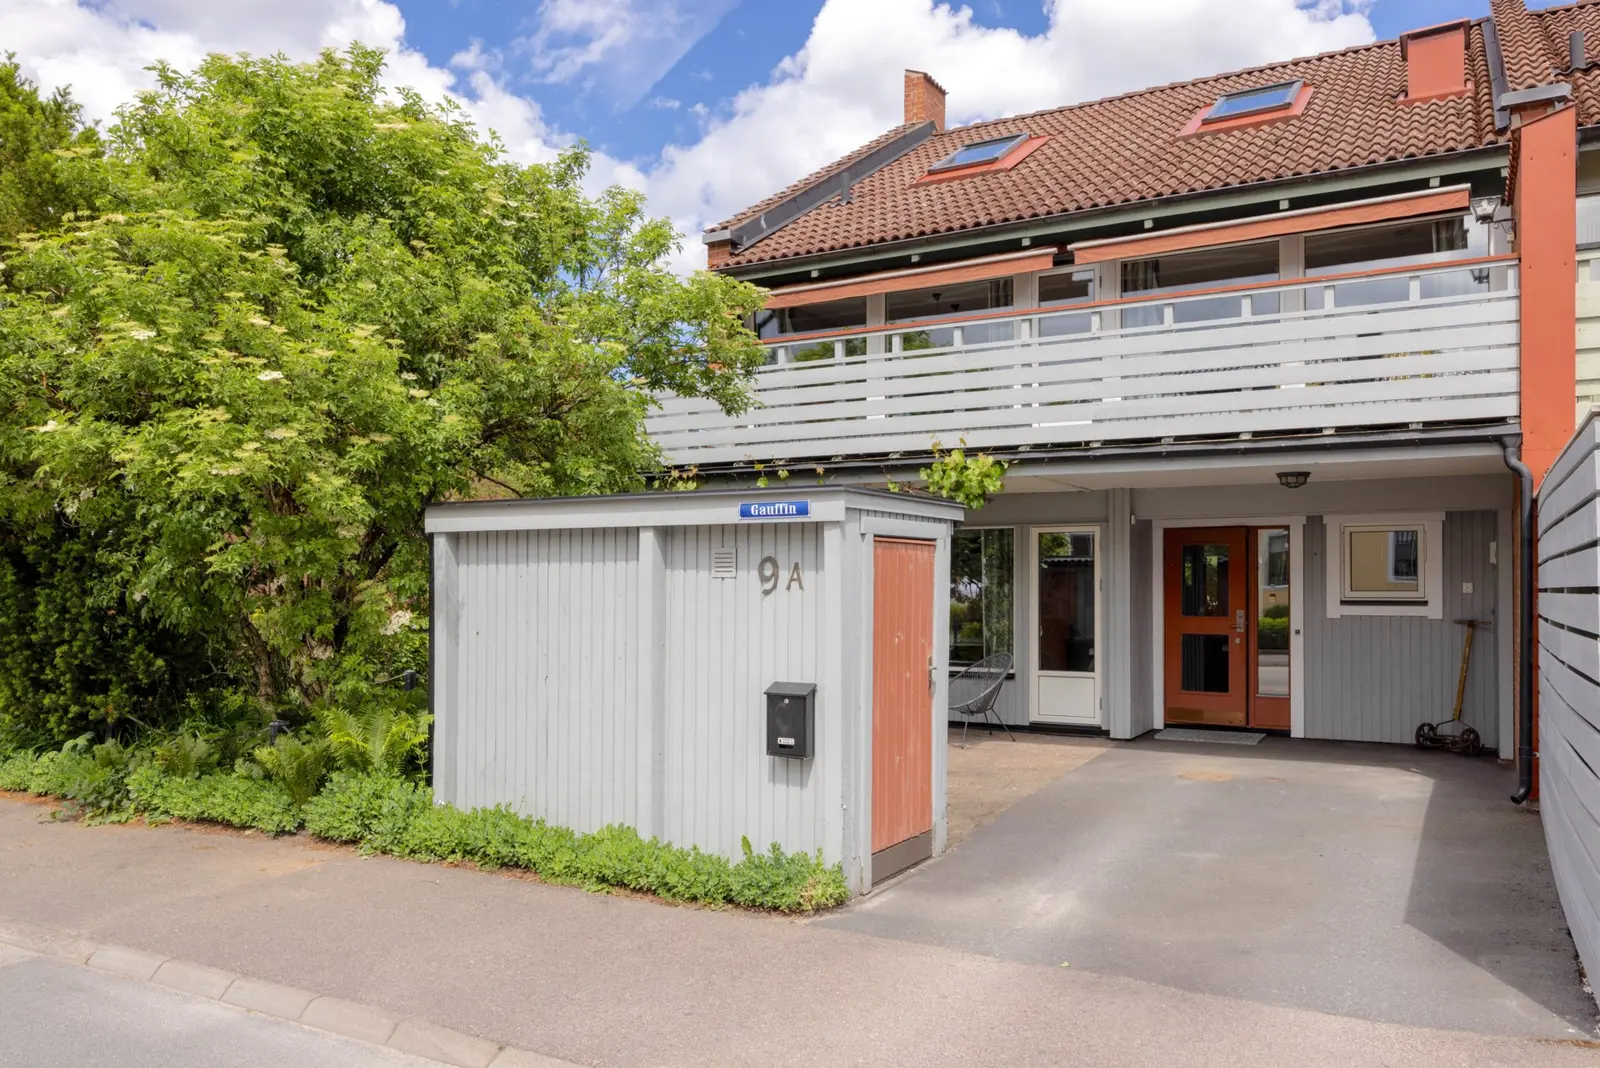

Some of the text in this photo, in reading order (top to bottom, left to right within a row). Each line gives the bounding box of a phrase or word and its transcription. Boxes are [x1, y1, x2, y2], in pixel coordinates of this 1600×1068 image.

[751, 503, 797, 515] Gauffin
[758, 555, 804, 596] 9 A
